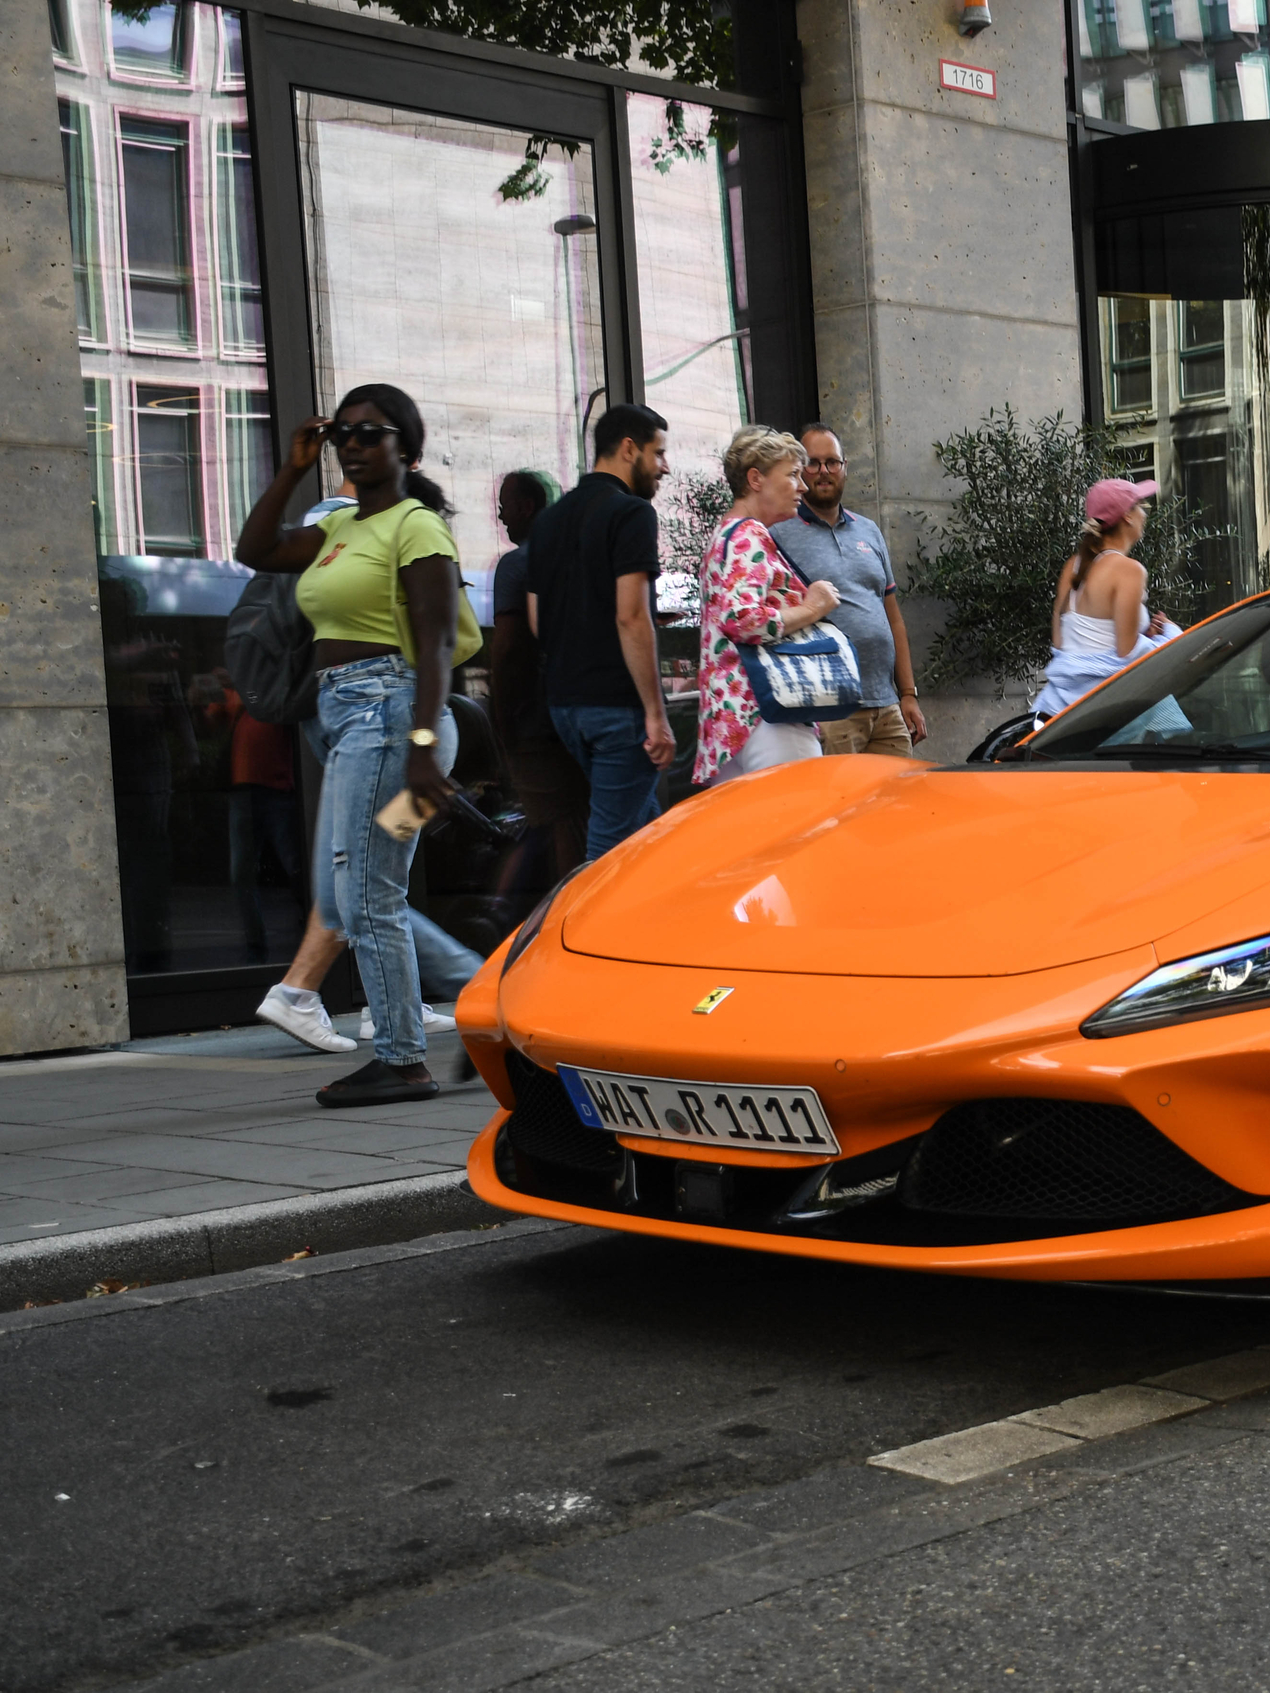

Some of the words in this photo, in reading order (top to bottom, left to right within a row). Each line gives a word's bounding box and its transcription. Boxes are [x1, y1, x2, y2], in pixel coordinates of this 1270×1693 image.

[953, 68, 984, 90] 1716
[581, 1103, 592, 1116] D
[583, 1077, 660, 1130] WAT
